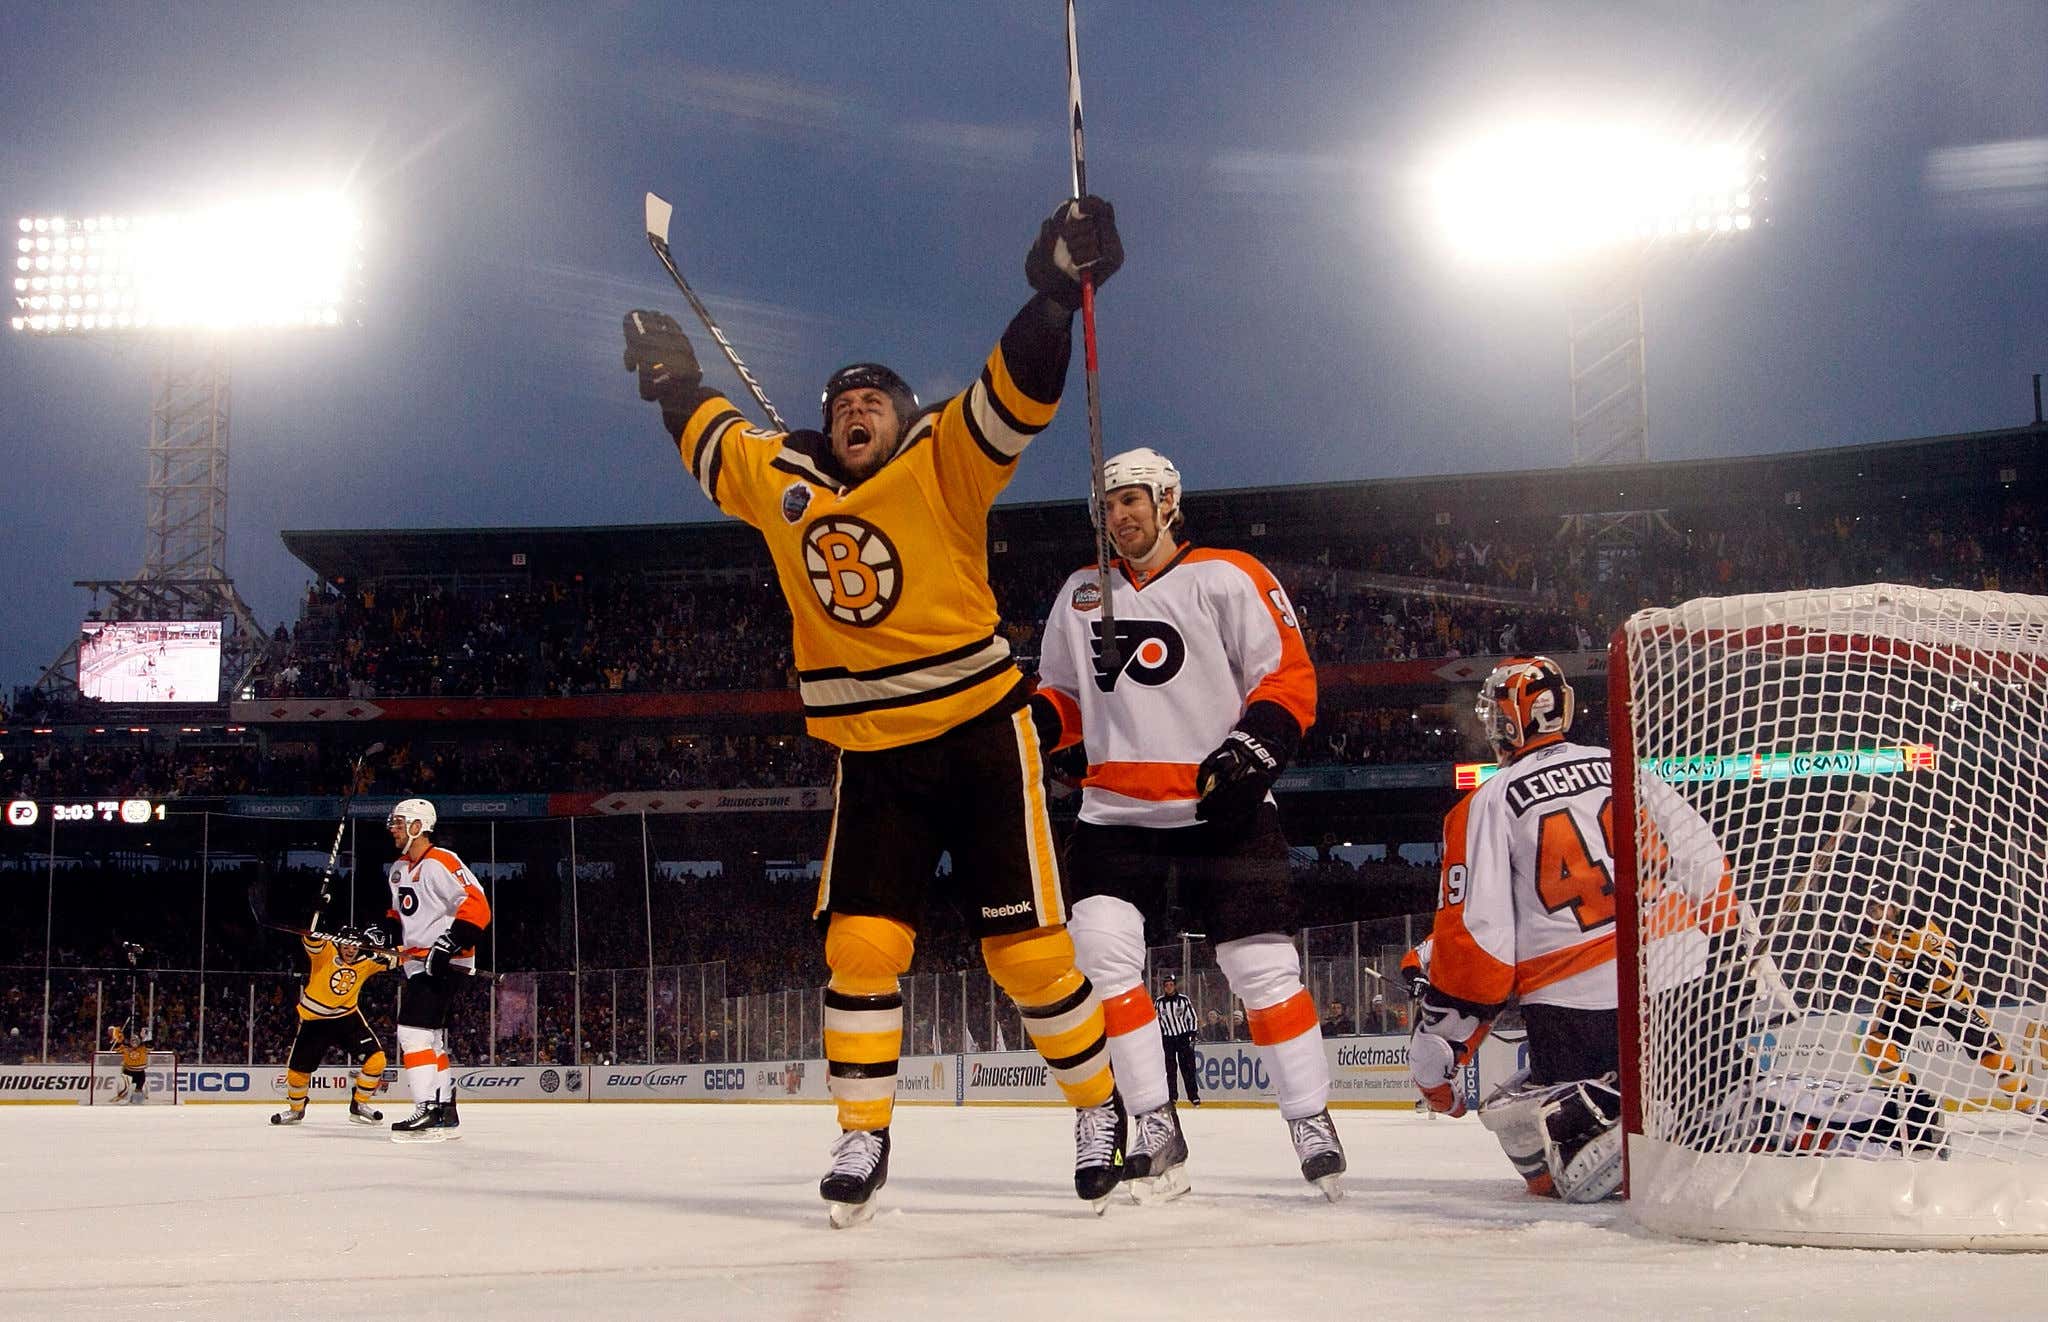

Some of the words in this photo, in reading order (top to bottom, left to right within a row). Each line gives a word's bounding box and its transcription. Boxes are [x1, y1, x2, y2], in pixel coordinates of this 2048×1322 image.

[1509, 761, 1612, 809] LEIGHTO
[53, 804, 94, 820] 3:03
[155, 804, 166, 820] 1
[462, 802, 506, 812] GEICO
[981, 900, 1032, 918] Reebok
[466, 1076, 525, 1087] LIGHT
[607, 1074, 643, 1086] BUD
[649, 1074, 688, 1086] LIGHT
[704, 1068, 745, 1090] GEICO
[971, 1063, 1048, 1088] BRIDGESTONE
[309, 1077, 331, 1089] HL
[333, 1077, 347, 1089] 10
[924, 1078, 930, 1089] it
